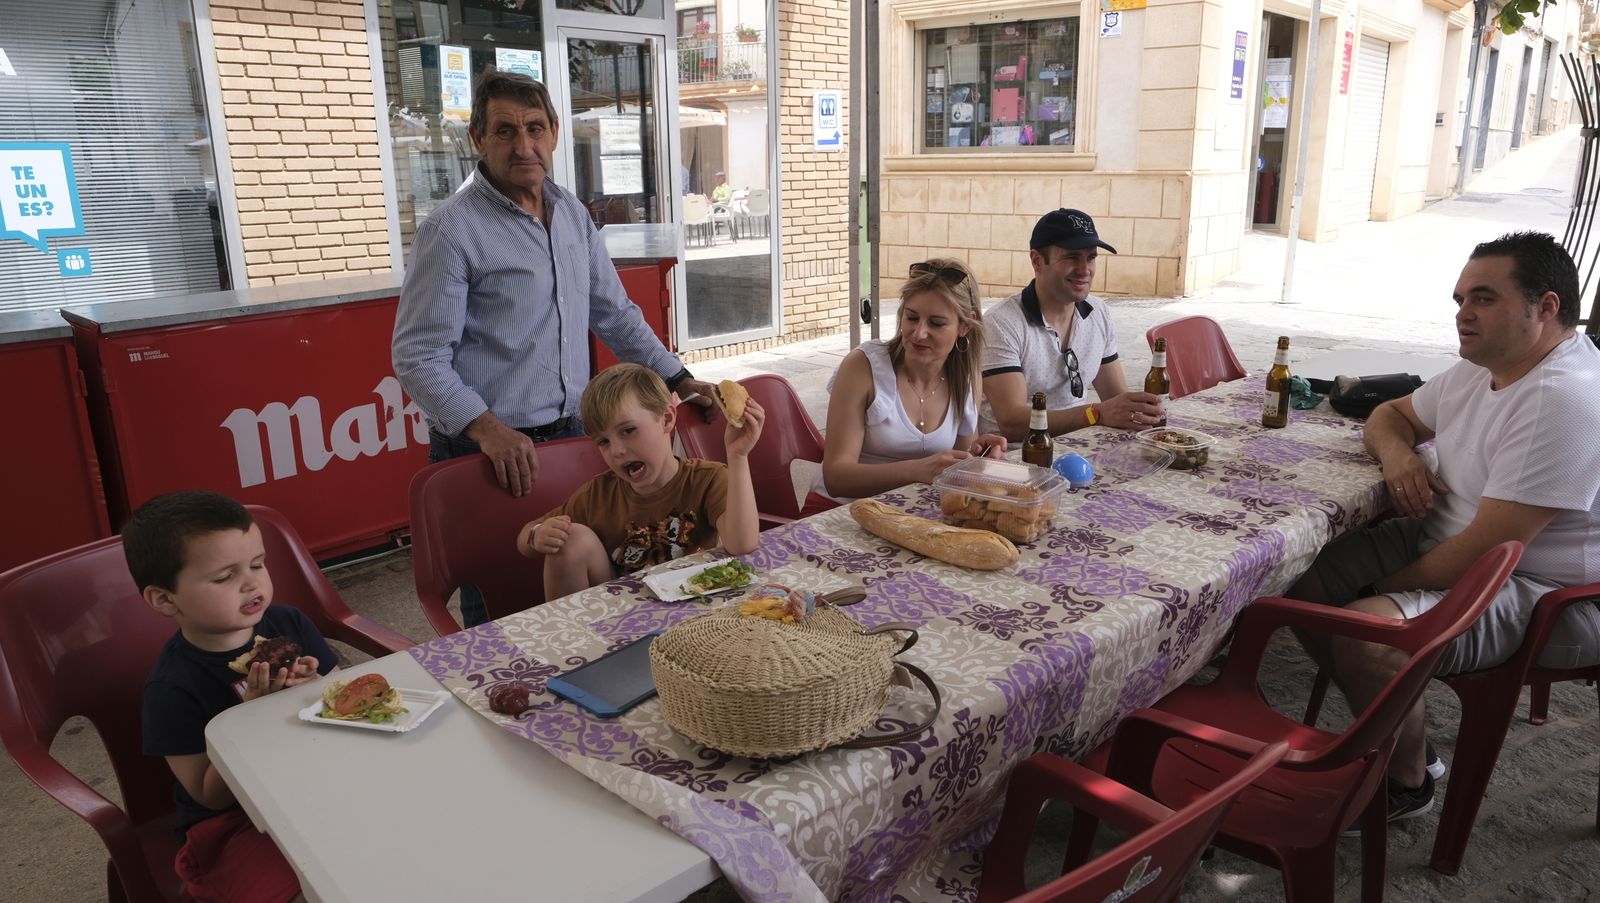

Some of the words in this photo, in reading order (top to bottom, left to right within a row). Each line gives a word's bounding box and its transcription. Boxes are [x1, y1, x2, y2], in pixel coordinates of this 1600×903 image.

[11, 166, 35, 180] TE
[15, 184, 48, 199] UN
[18, 201, 54, 217] ES?
